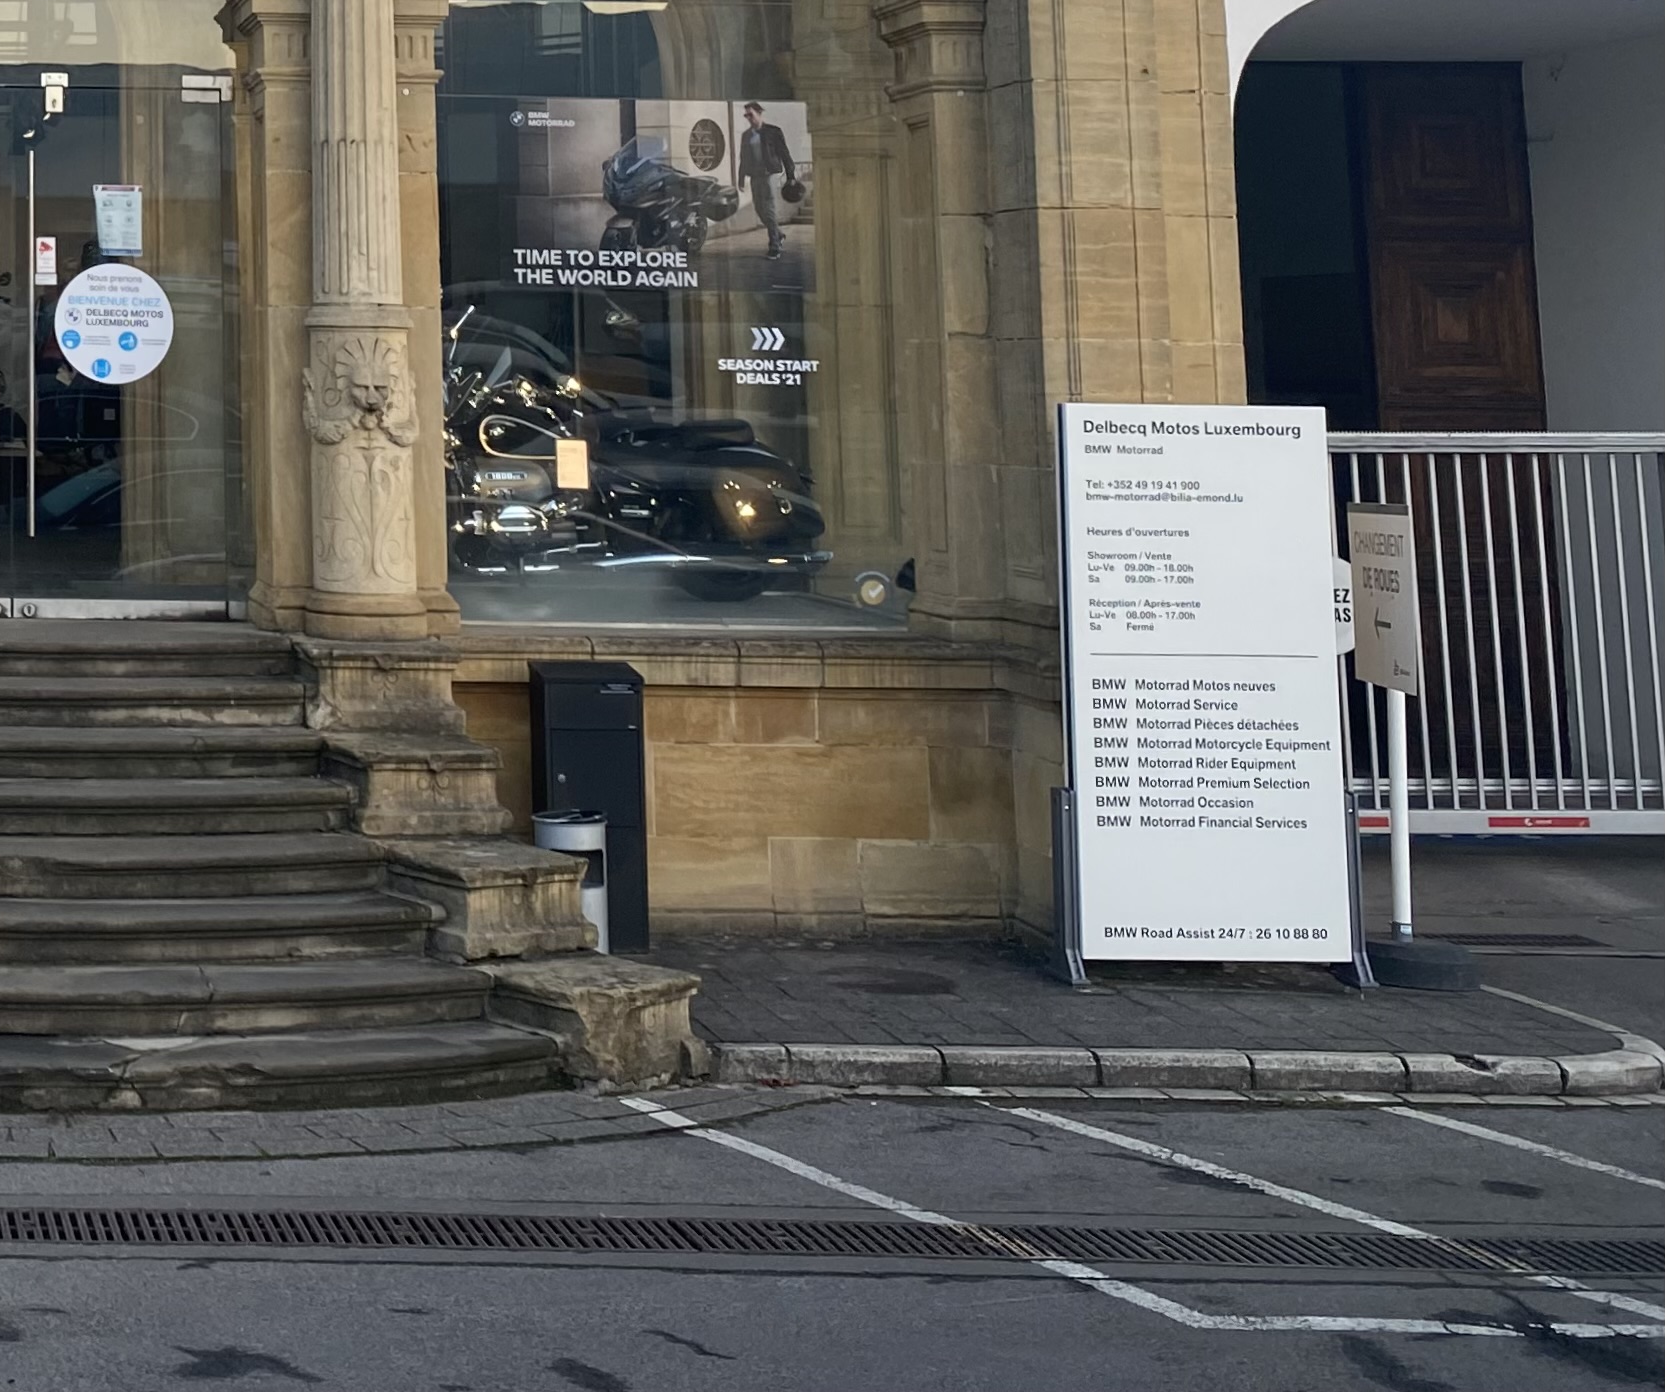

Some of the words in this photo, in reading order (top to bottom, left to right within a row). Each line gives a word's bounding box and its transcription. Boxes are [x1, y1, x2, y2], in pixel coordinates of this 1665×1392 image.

[513, 249, 562, 266] TIME
[565, 250, 596, 266] TO
[599, 250, 688, 268] EXPLORE
[87, 274, 107, 282] Nous
[514, 268, 554, 285] THE
[557, 269, 632, 286] WORLD
[636, 271, 698, 288] AGAIN
[68, 296, 128, 306] BIENVENUE
[131, 297, 161, 307] CHEZ
[86, 309, 128, 317] DELBECQ
[131, 310, 164, 319] MOTOS
[86, 319, 149, 327] LUXEMBOURG
[718, 358, 775, 372] SEASON
[777, 359, 819, 372] START
[736, 372, 780, 385] DEALS
[1083, 420, 1147, 437] Delbecq
[1151, 421, 1200, 434] Motos
[1204, 422, 1302, 439] Luxembourg
[1085, 444, 1112, 454] BMW
[1117, 445, 1164, 455] Motorrad
[1086, 479, 1104, 489] Tel:
[1107, 480, 1132, 489] +352
[1135, 481, 1148, 489] 49
[1151, 481, 1163, 490] 19
[1165, 481, 1178, 490] 41
[1180, 481, 1200, 490] 900
[1086, 492, 1243, 502] bmw-motorrad@bilia-emond.lu
[1087, 527, 1123, 536] Heures
[1126, 528, 1190, 537] d'ouvertures
[1087, 551, 1137, 560] Showroom
[1144, 552, 1172, 560] Vente
[1088, 563, 1115, 572] Lu-Ve
[1124, 563, 1155, 572] 09.00h
[1164, 564, 1194, 572] 18.00h
[1088, 575, 1100, 583] Sa
[1125, 575, 1155, 583] 09.00h
[1164, 575, 1194, 584] 17.00h
[1362, 566, 1373, 589] DE
[1374, 568, 1400, 593] ROUES
[1089, 598, 1136, 608] Réception
[1089, 611, 1116, 619] Lu-Ve
[1165, 611, 1195, 620] 17.00h
[1089, 622, 1101, 630] Sa
[1126, 622, 1154, 631] Fermé
[1092, 679, 1126, 690] BMW
[1135, 679, 1189, 691] Motorrad
[1193, 679, 1230, 691] Motos
[1233, 682, 1276, 692] neuves
[1093, 698, 1127, 709] BMW
[1136, 699, 1190, 710] Motorrad
[1194, 699, 1238, 711] Service
[1093, 718, 1127, 729] BMW
[1136, 718, 1191, 730] Motorrad
[1194, 718, 1234, 730] Pièces
[1237, 719, 1299, 731] détachées
[1094, 737, 1128, 748] BMW
[1137, 738, 1192, 749] Motorrad
[1195, 738, 1263, 752] Motorcycle
[1265, 739, 1331, 752] Equipment
[1095, 757, 1129, 768] BMW
[1138, 757, 1192, 769] Motorrad
[1196, 758, 1228, 769] Rider
[1231, 758, 1296, 772] Equipment
[1095, 776, 1130, 787] BMW
[1138, 777, 1193, 788] Motorrad
[1197, 777, 1250, 789] Premium
[1254, 778, 1310, 789] Selection
[1096, 796, 1130, 807] BMW
[1139, 796, 1194, 808] Motorrad
[1198, 796, 1254, 809] Occasion
[1097, 816, 1131, 827] BMW
[1140, 816, 1195, 828] Motorrad
[1199, 816, 1252, 828] Financial
[1256, 816, 1308, 829] Services
[1104, 927, 1137, 938] BMW
[1141, 927, 1173, 938] Road
[1176, 927, 1215, 939] Assist
[1218, 928, 1245, 939] 24/7
[1256, 928, 1272, 939] 26
[1276, 928, 1290, 939] 10
[1293, 928, 1309, 939] 88
[1312, 928, 1328, 939] 80
